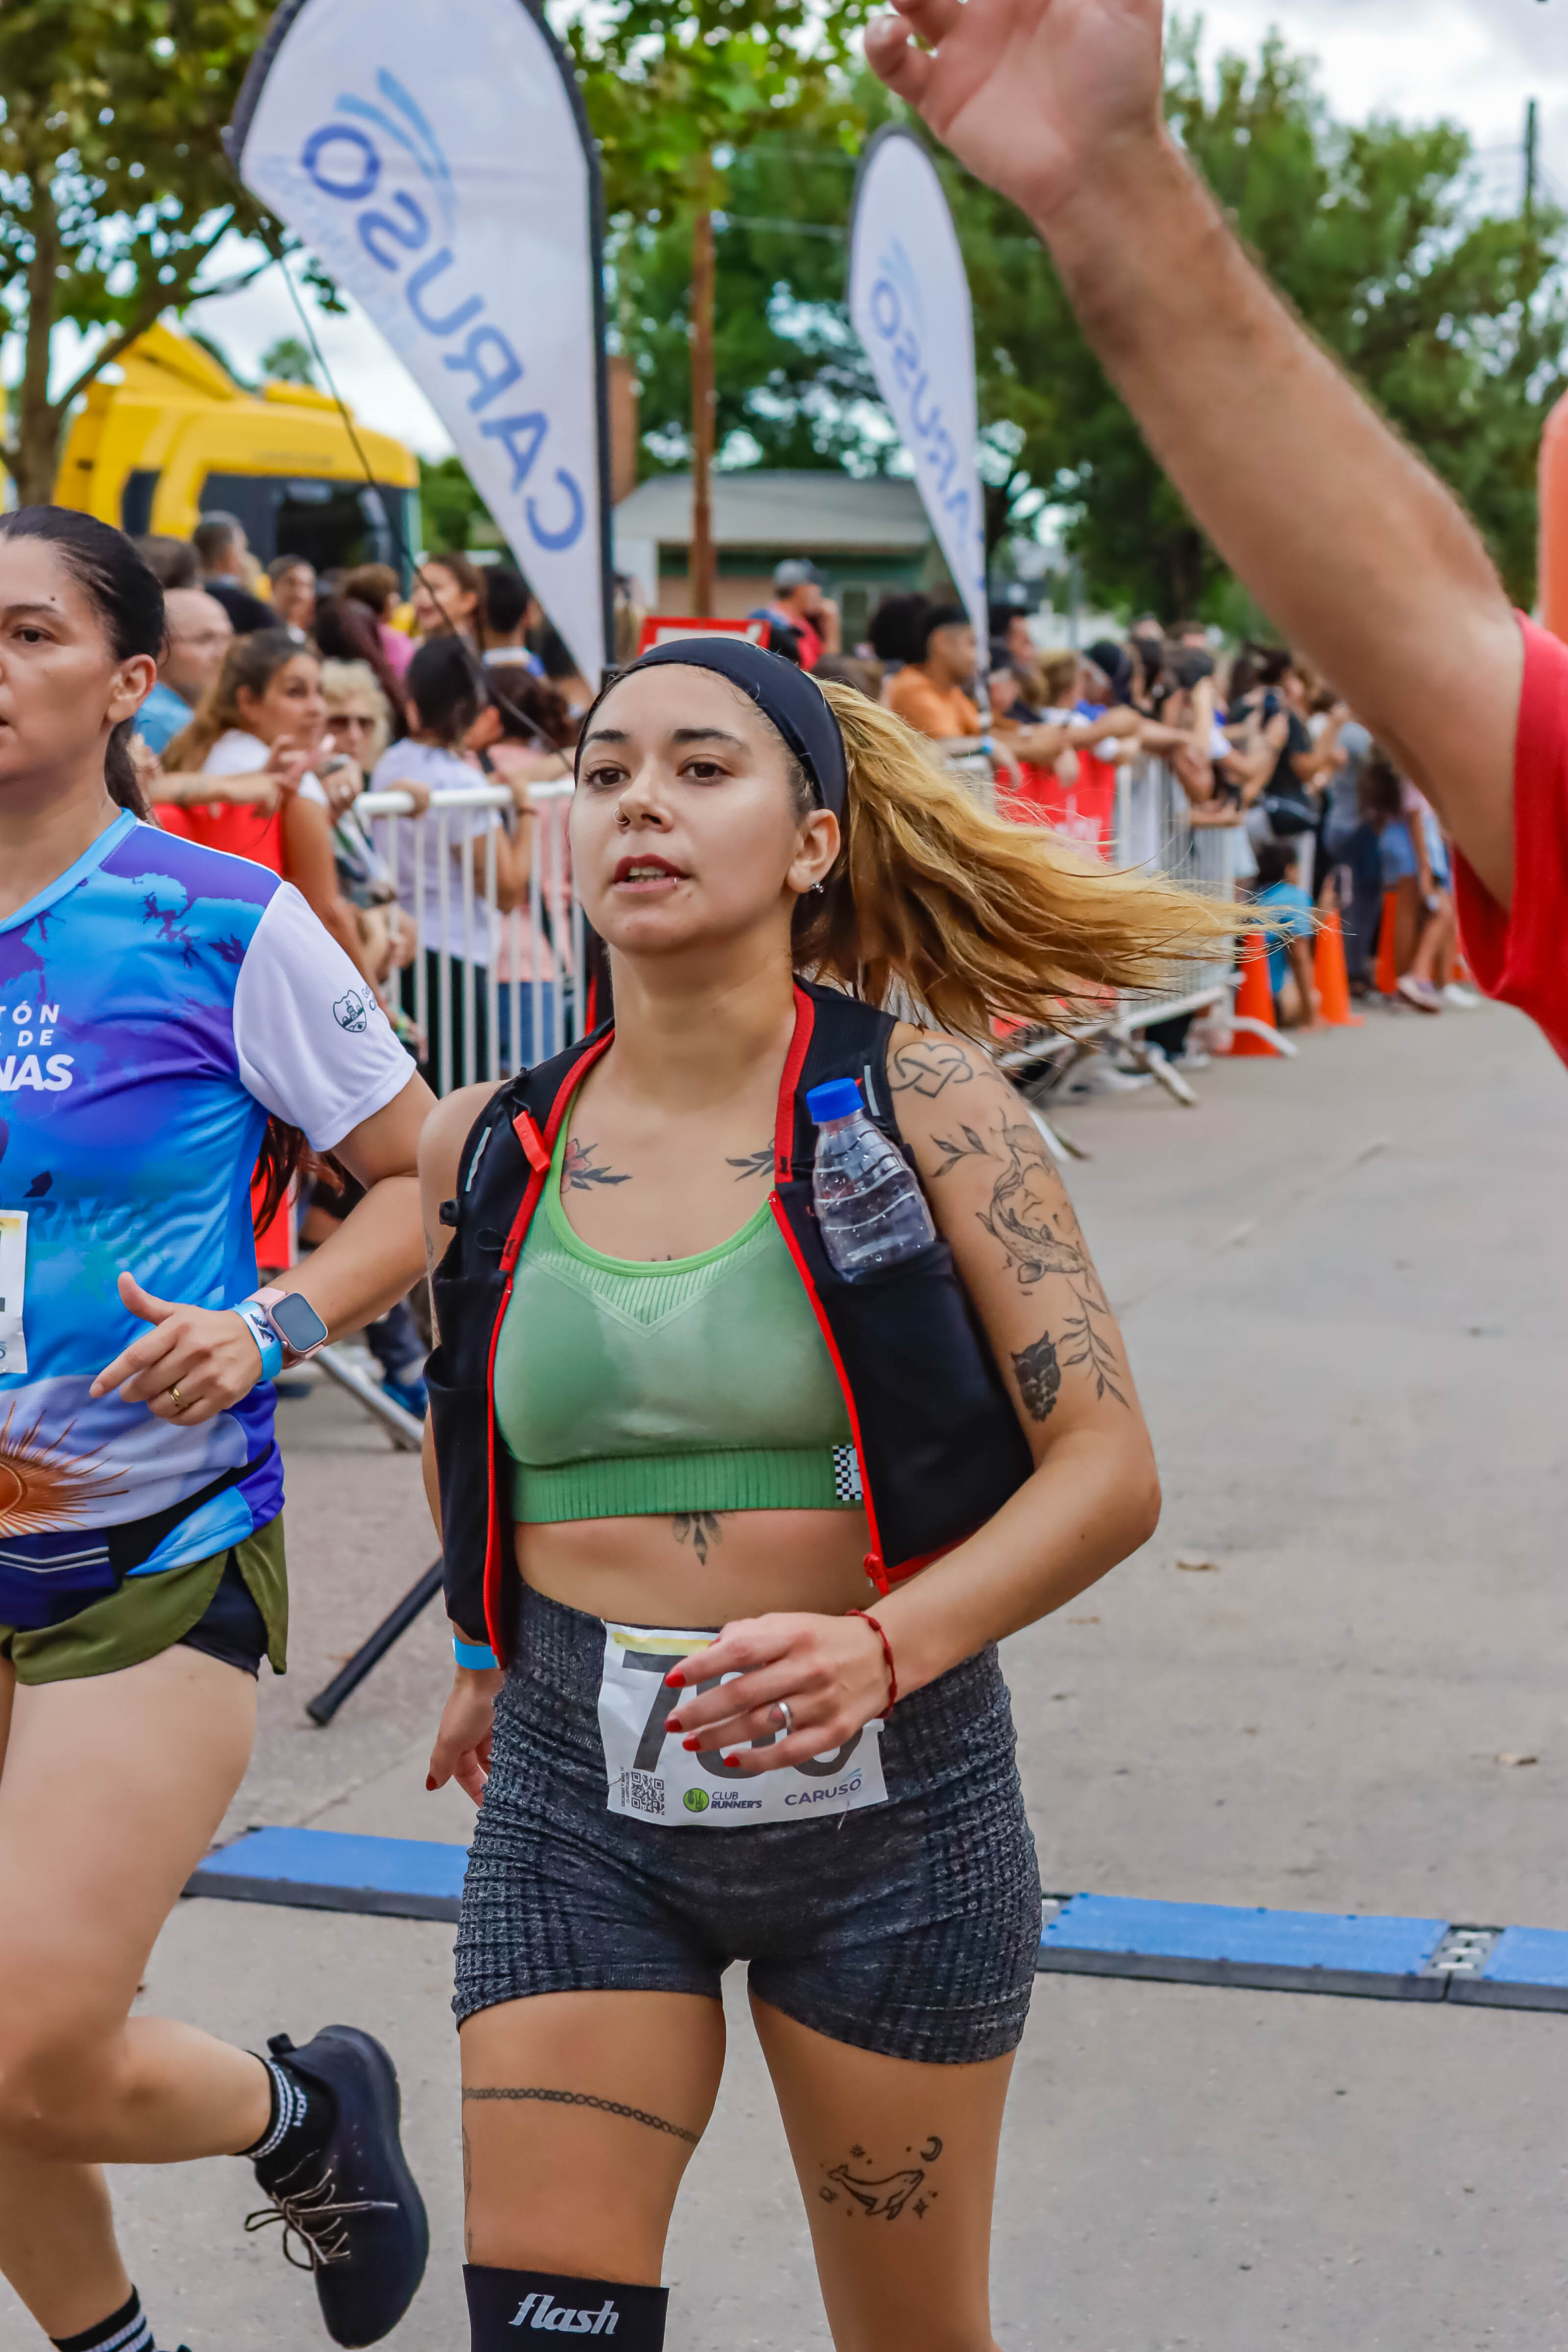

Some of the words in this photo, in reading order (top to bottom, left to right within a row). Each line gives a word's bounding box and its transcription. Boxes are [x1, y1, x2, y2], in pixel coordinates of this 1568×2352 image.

[17, 1029, 54, 1047] DE
[712, 1791, 738, 1800] CLUB
[784, 1778, 862, 1806] CARUSO
[710, 1800, 762, 1809] RUNNER'S
[508, 2293, 619, 2335] flash
